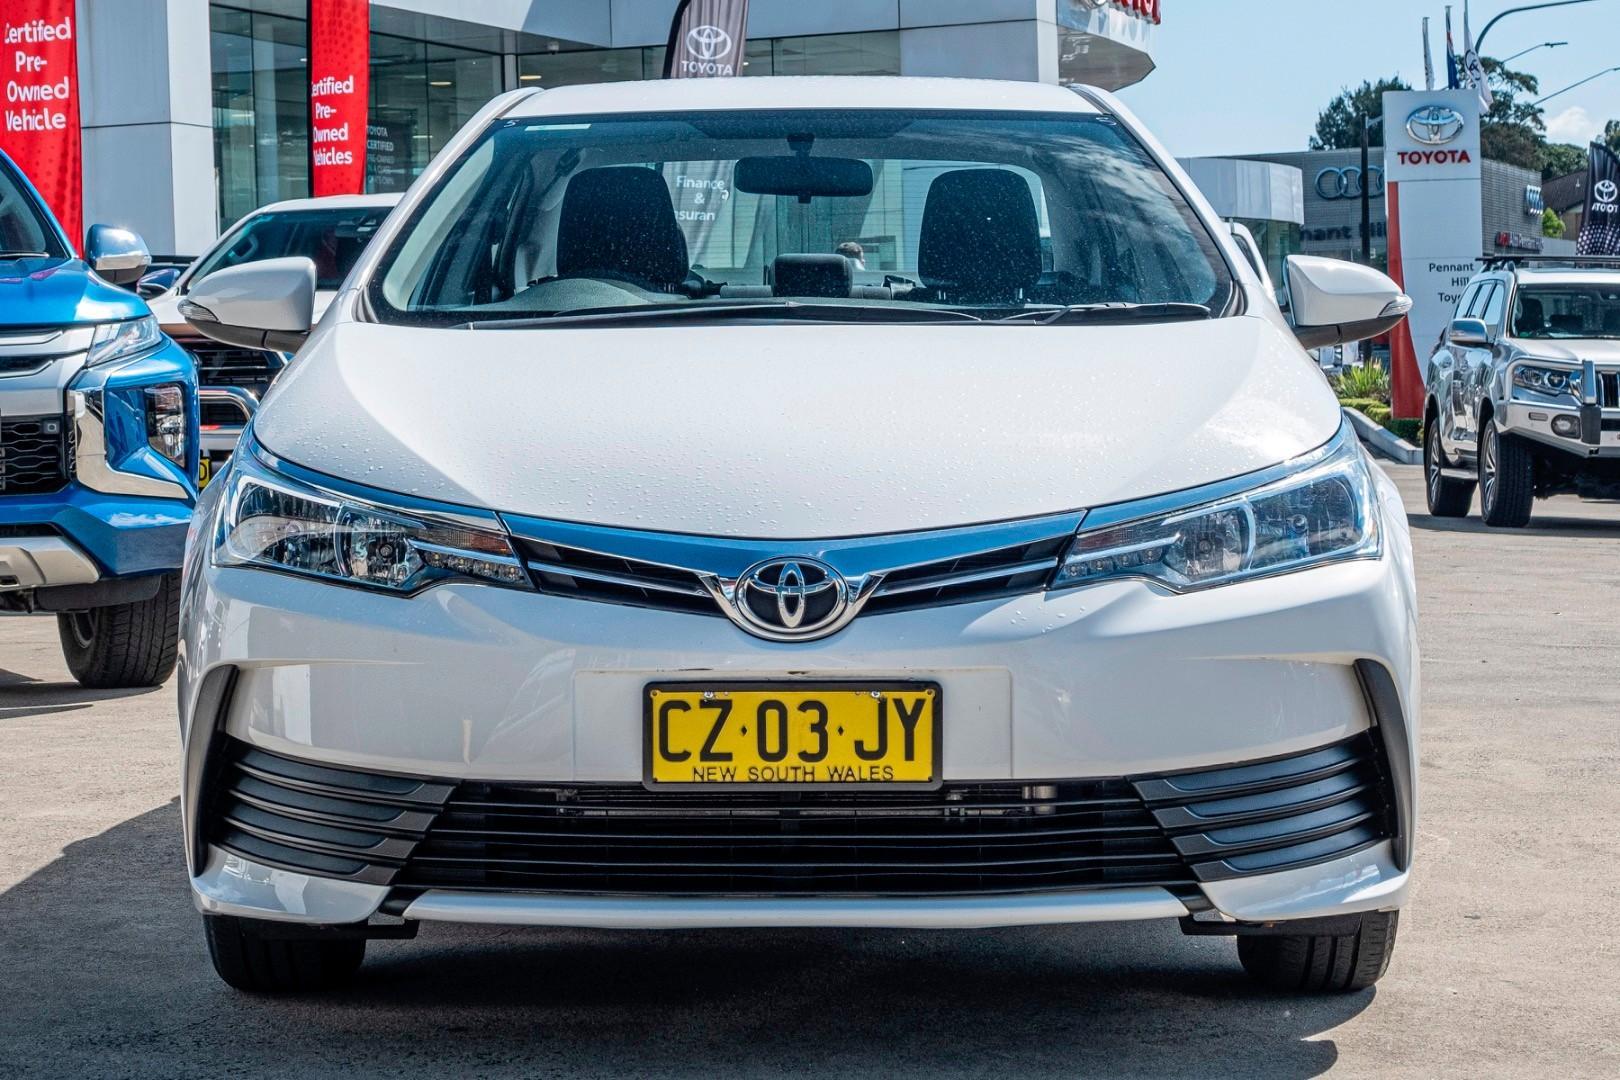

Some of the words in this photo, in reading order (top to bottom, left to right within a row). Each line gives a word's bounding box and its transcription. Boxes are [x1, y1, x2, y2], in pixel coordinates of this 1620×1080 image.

[15, 50, 48, 73] Pre-
[681, 60, 734, 76] TOYOTA
[7, 75, 70, 102] Owned
[311, 74, 355, 97] ertified
[5, 107, 67, 131] Vehicle
[315, 102, 338, 119] Pre-
[313, 122, 349, 143] Owned
[313, 147, 353, 166] Vehicles
[1396, 149, 1472, 165] TOYOTA
[676, 175, 726, 190] Finance
[694, 192, 705, 204] &
[1428, 262, 1475, 273] Pennant
[693, 766, 738, 783] NEW
[748, 765, 817, 783] SOUTH
[828, 765, 895, 782] WALES
